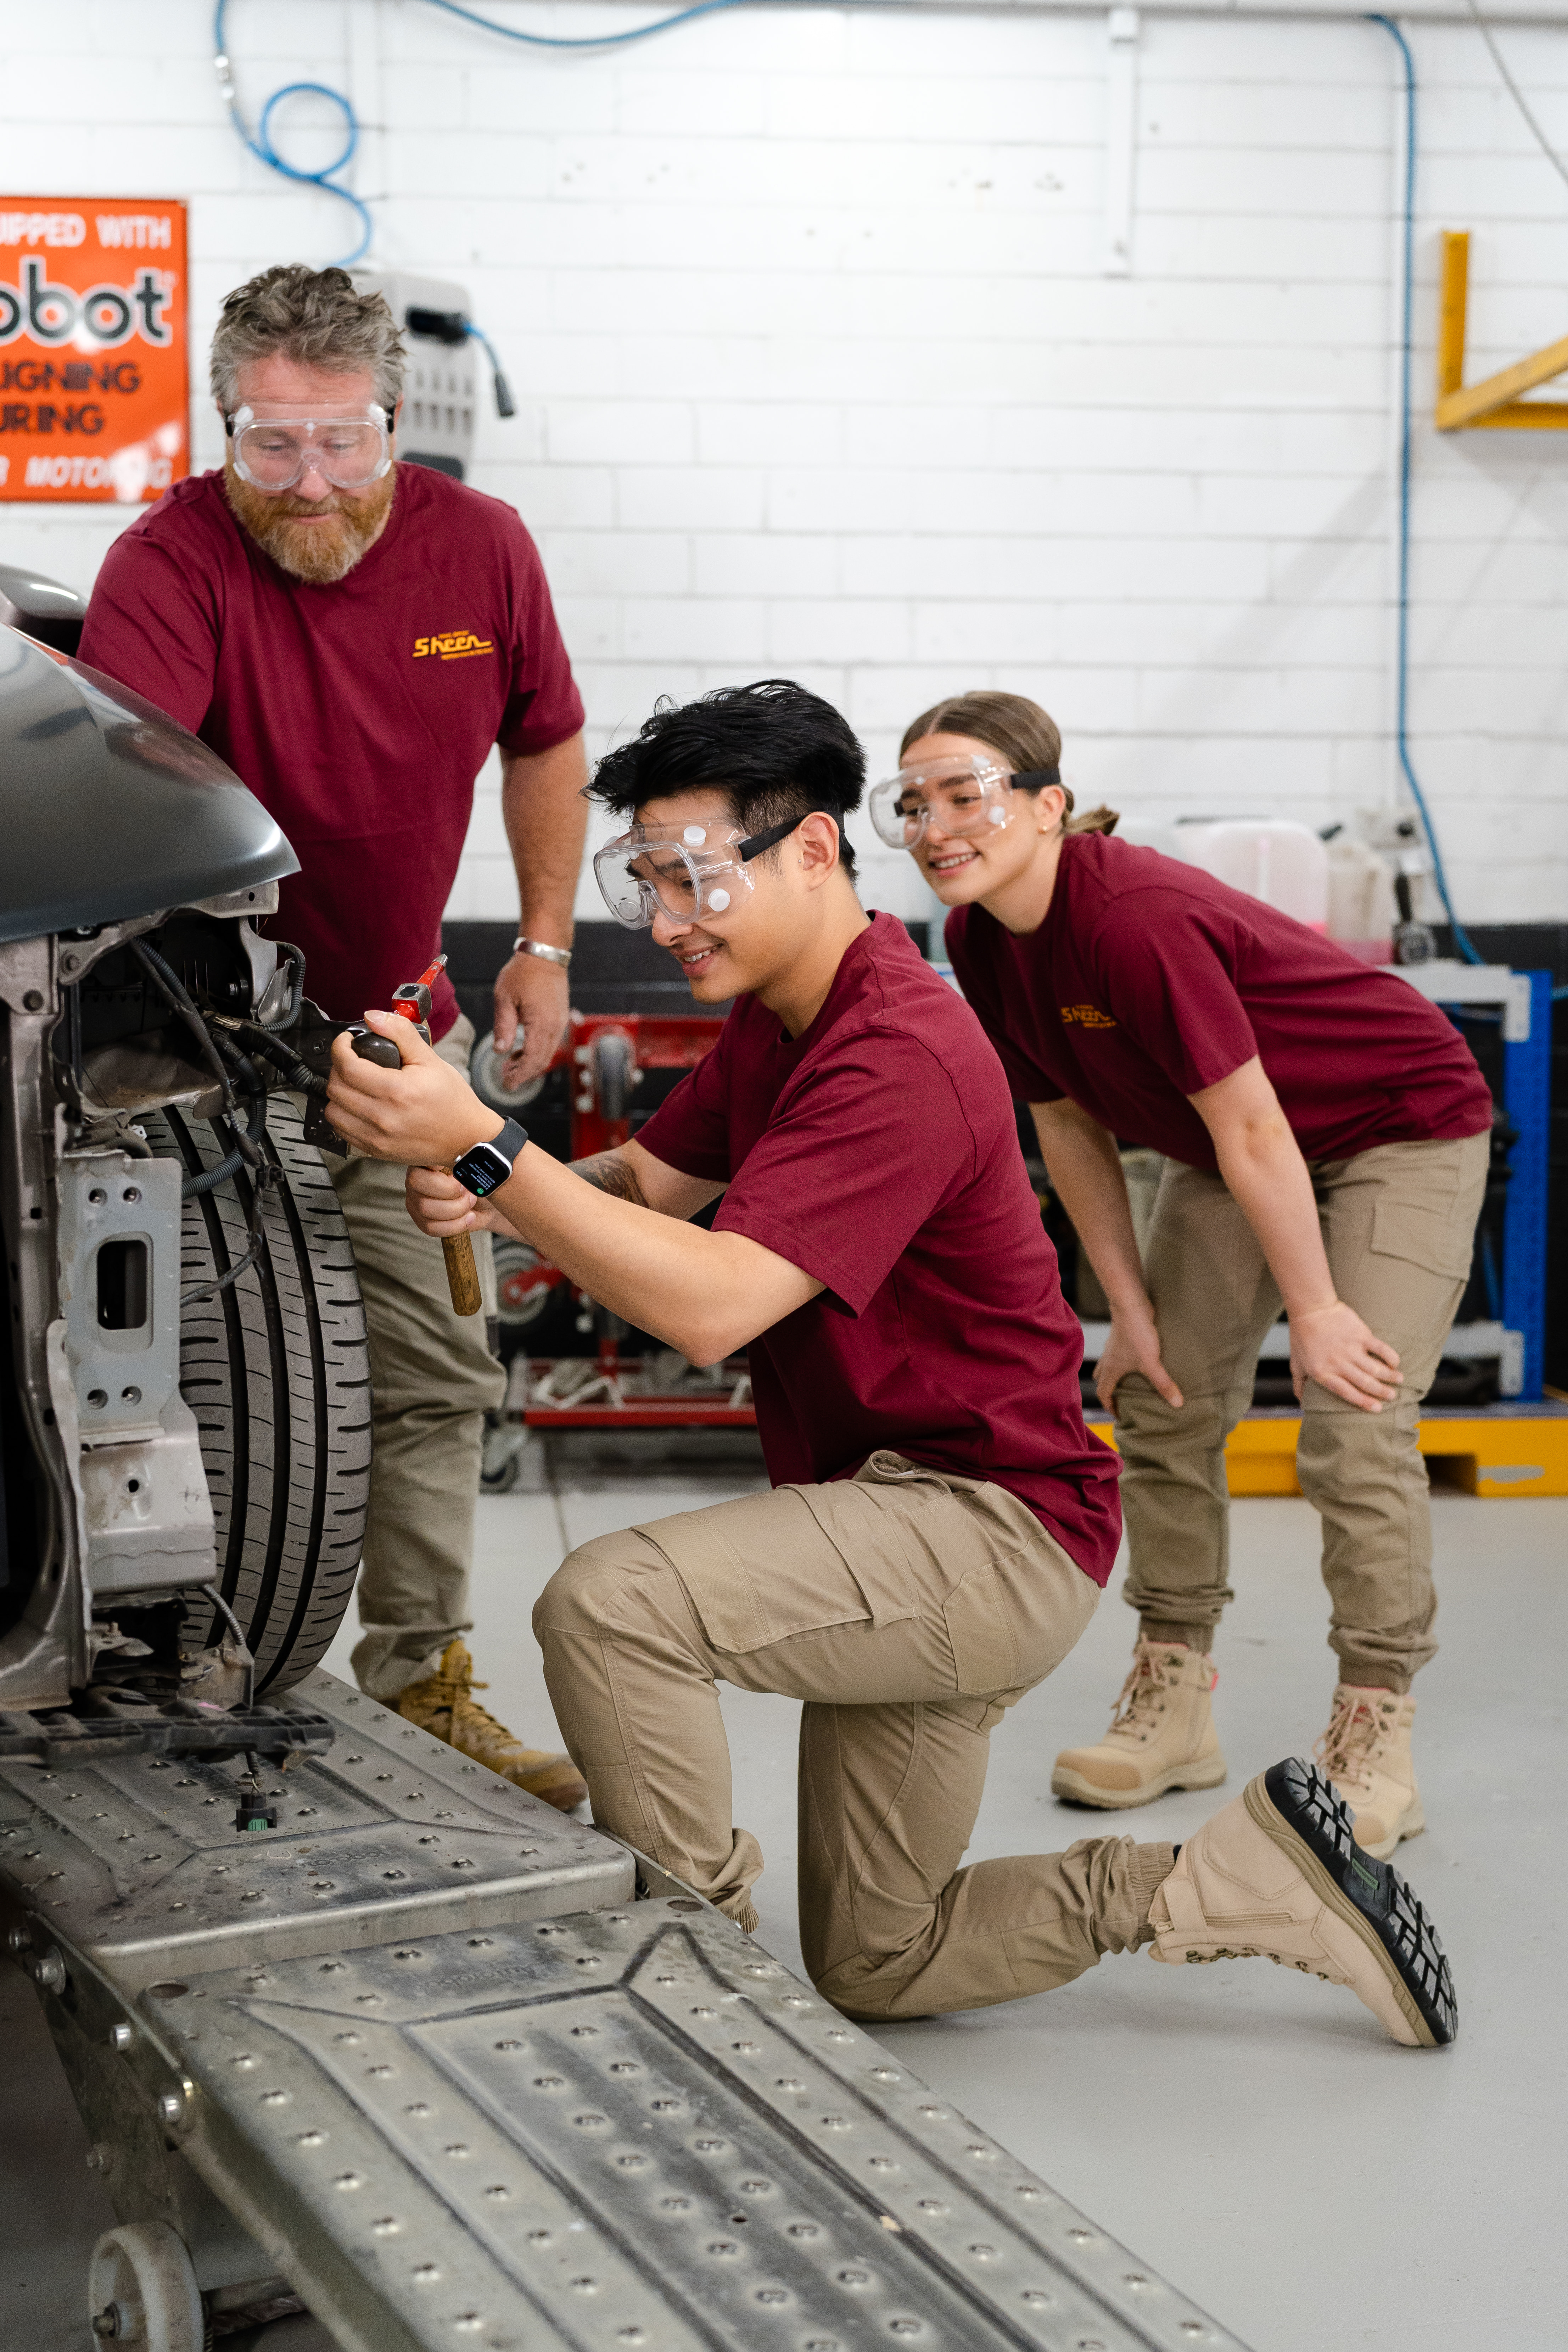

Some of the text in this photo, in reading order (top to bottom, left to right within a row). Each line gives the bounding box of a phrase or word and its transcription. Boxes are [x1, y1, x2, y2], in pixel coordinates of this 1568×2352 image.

[0, 212, 172, 249] IPPED WITH
[0, 361, 140, 394] IGNING
[469, 1163, 477, 1171] longer
[484, 1161, 494, 1170] Dismiss
[476, 1175, 486, 1184] behind
[484, 1173, 495, 1183] detected
[476, 1179, 486, 1188] devices
